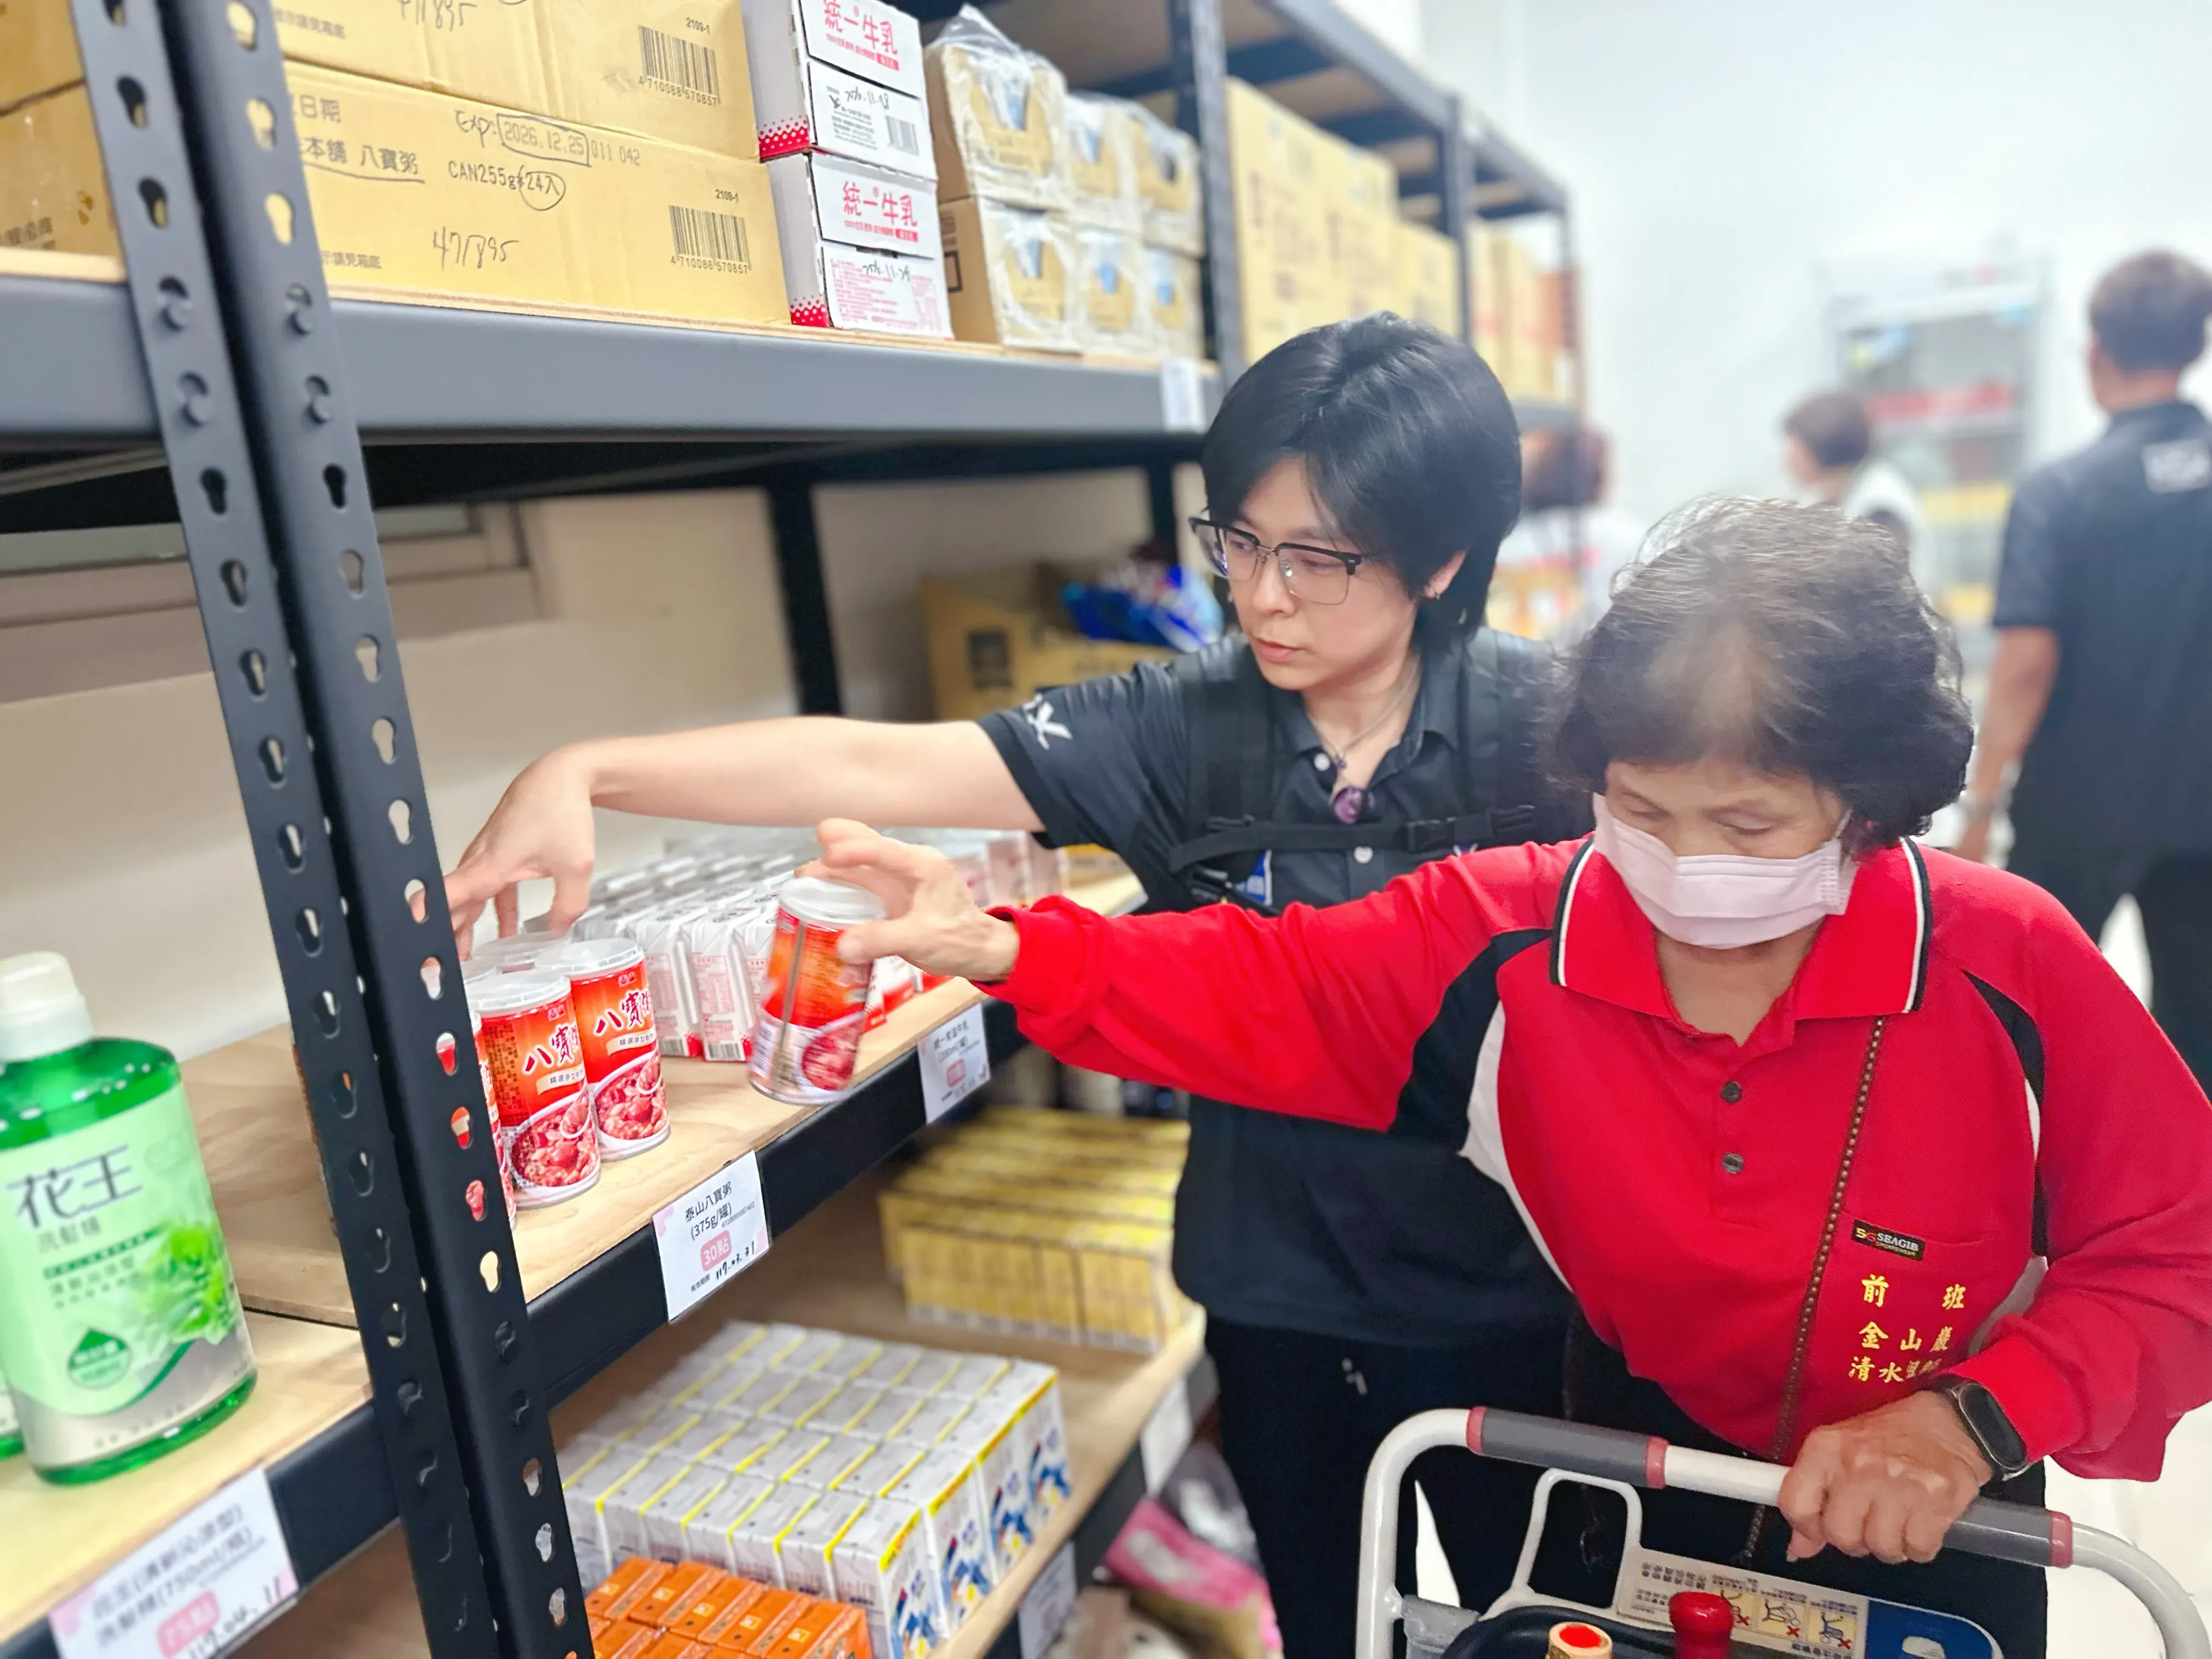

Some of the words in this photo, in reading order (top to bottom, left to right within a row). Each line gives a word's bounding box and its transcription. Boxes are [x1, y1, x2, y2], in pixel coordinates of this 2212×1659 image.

[291, 94, 341, 123] 日期
[301, 136, 347, 164] 本舖
[360, 144, 419, 175] 八寶粥
[843, 180, 918, 227] 統一牛乳
[7, 1144, 143, 1228] 花王
[685, 1181, 732, 1223] 泰山八寶粥
[691, 1202, 732, 1241] (375g/罐)
[703, 1236, 730, 1266] 30點
[1876, 1232, 1920, 1251] SEAGIB
[1861, 1273, 1890, 1308] 前
[1942, 1283, 1966, 1310] 班
